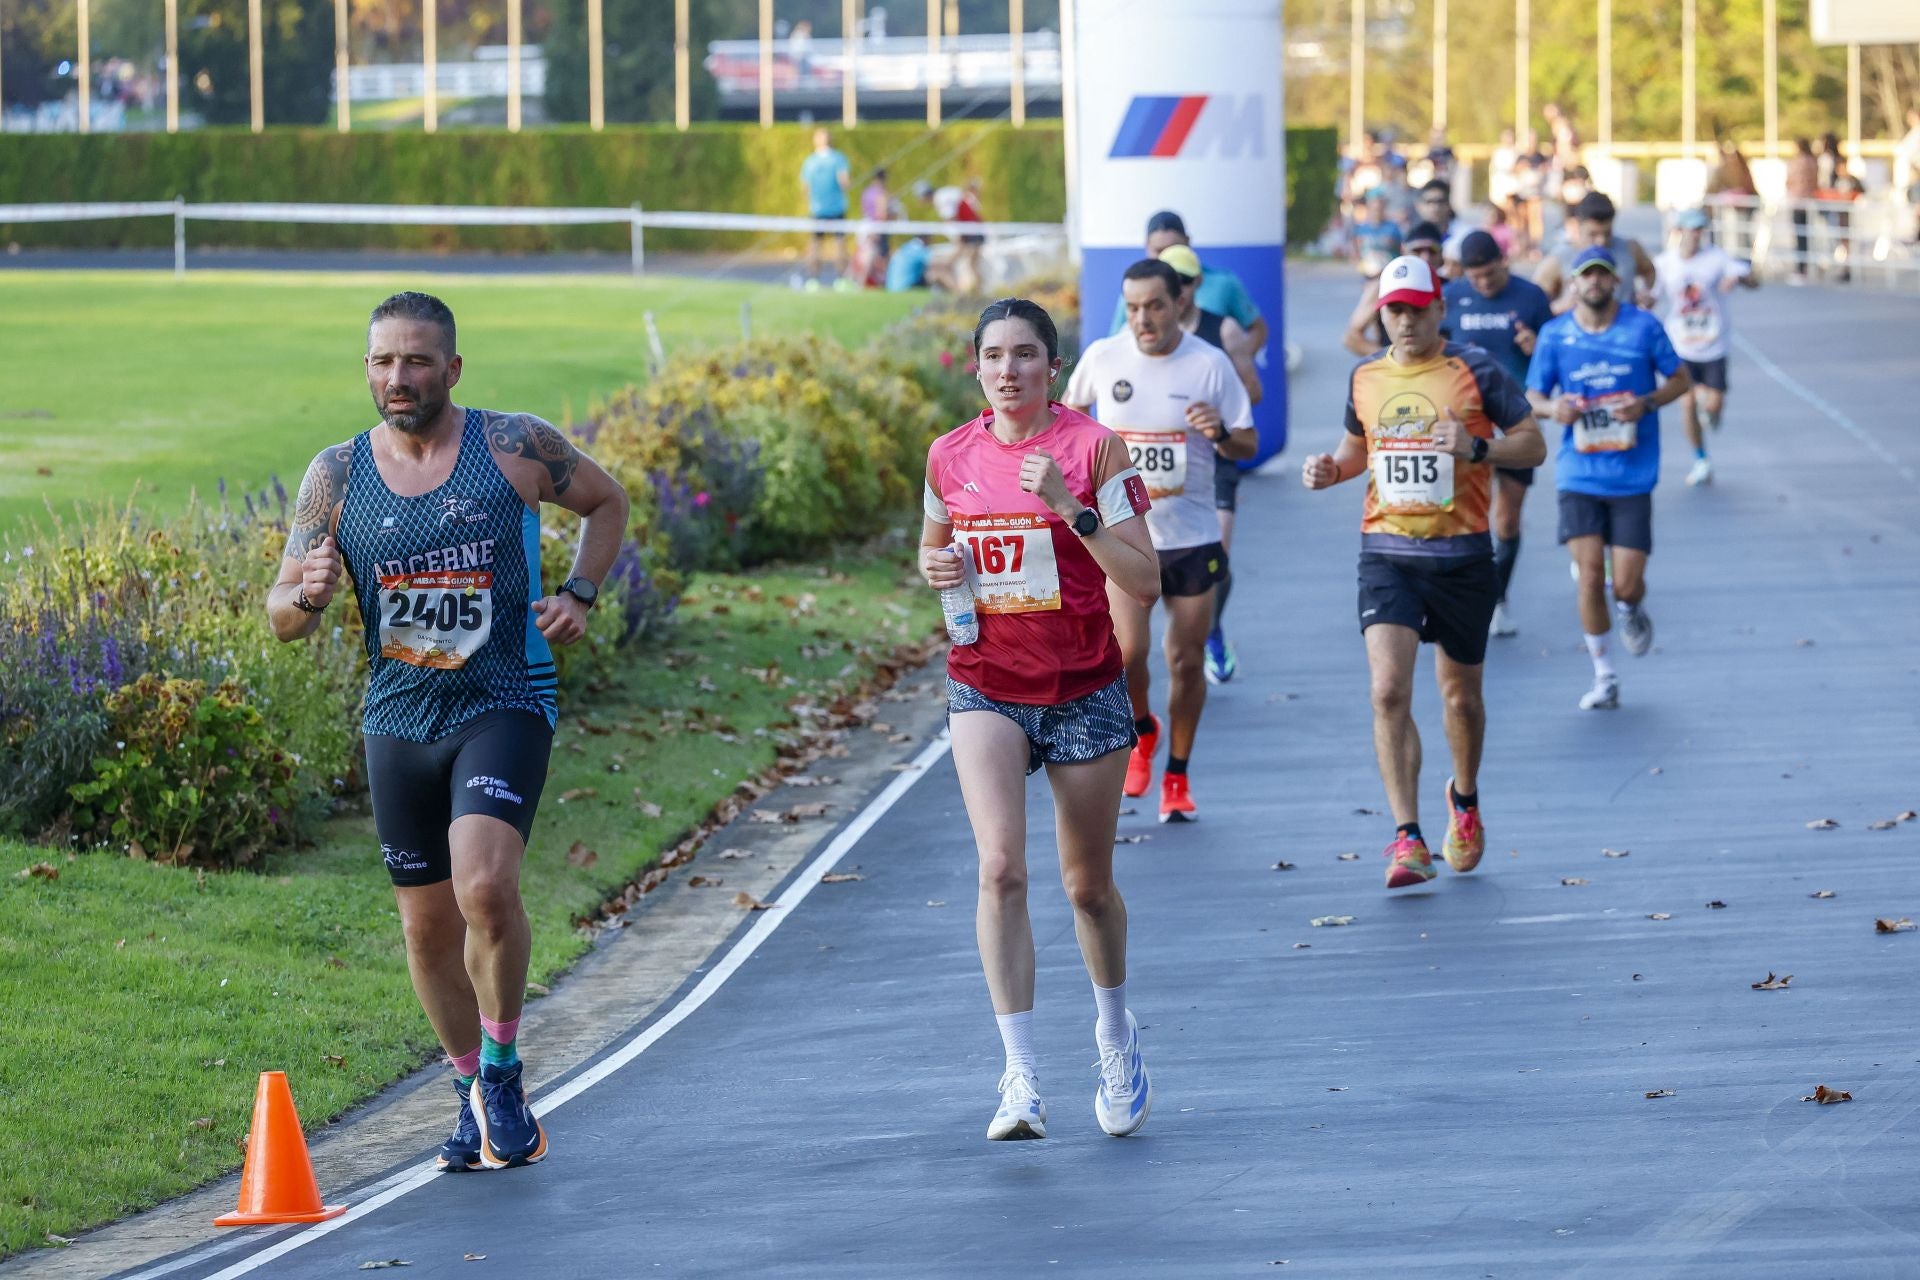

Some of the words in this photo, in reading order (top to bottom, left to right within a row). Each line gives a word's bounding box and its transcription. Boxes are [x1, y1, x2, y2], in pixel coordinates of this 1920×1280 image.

[1384, 455, 1438, 483] 1513
[408, 538, 495, 576] CERNE
[968, 535, 1025, 575] 167
[451, 575, 475, 585] GIJÓN
[388, 592, 483, 632] 2405
[403, 861, 428, 870] cerne
